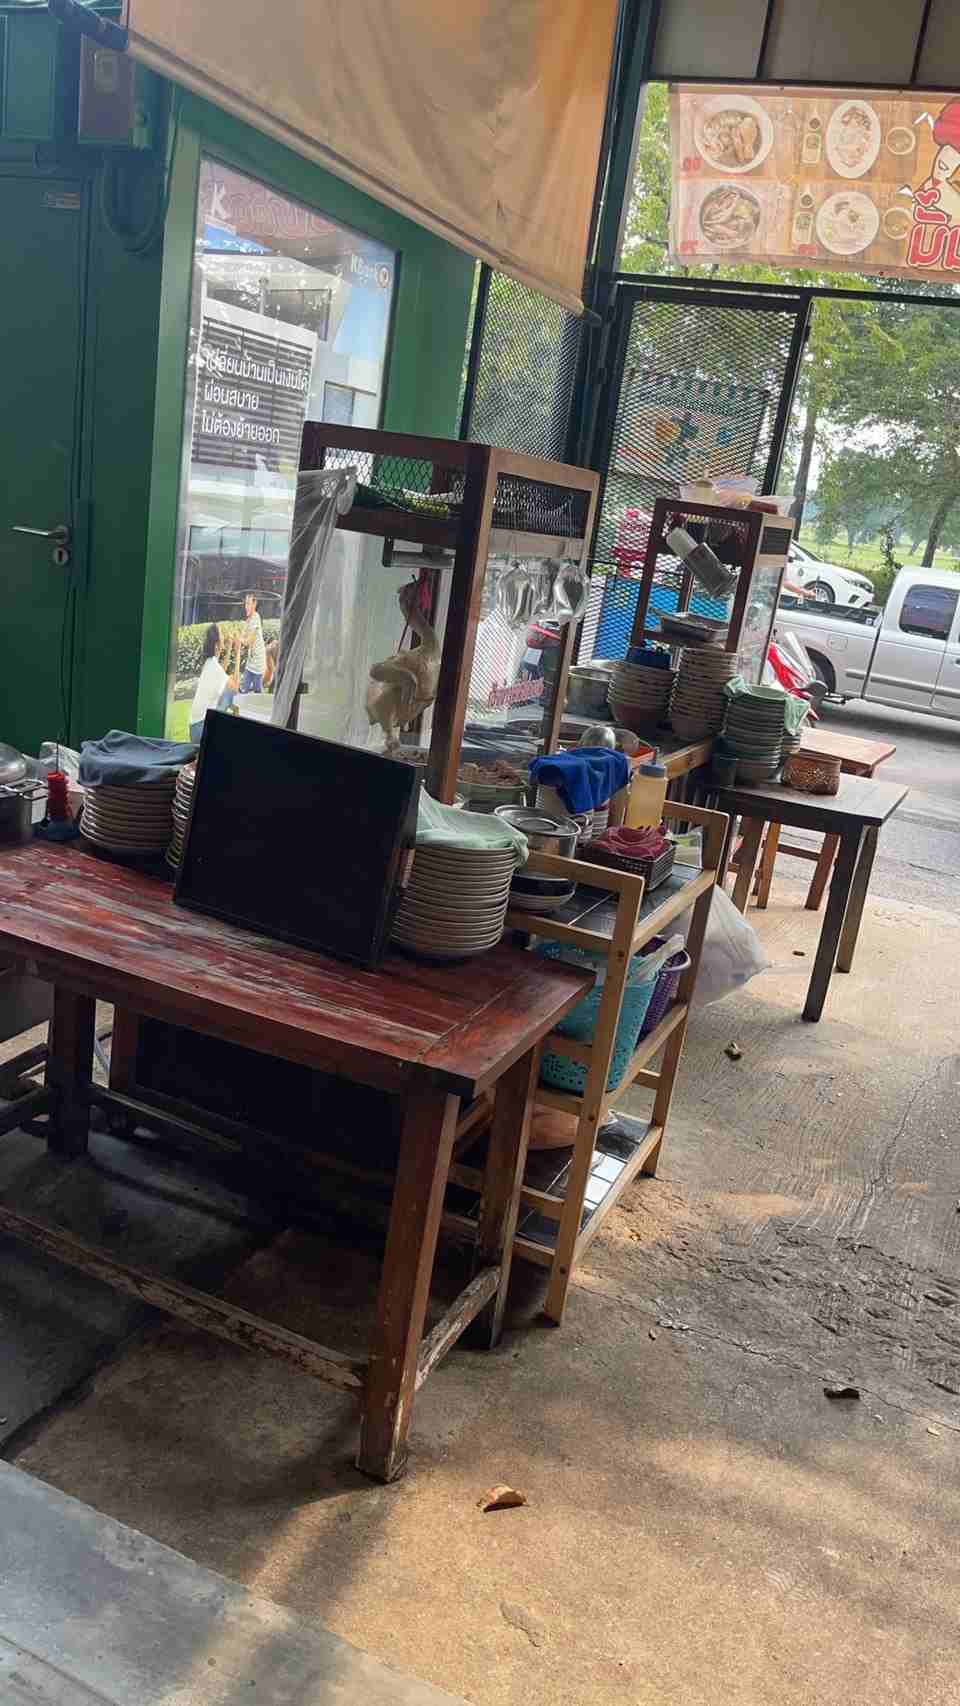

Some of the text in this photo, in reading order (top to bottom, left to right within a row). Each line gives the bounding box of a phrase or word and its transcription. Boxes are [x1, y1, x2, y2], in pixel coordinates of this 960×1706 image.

[204, 378, 260, 411] ผ่อนสบาย
[201, 408, 281, 444] ไม่ต้องย้ายออก
